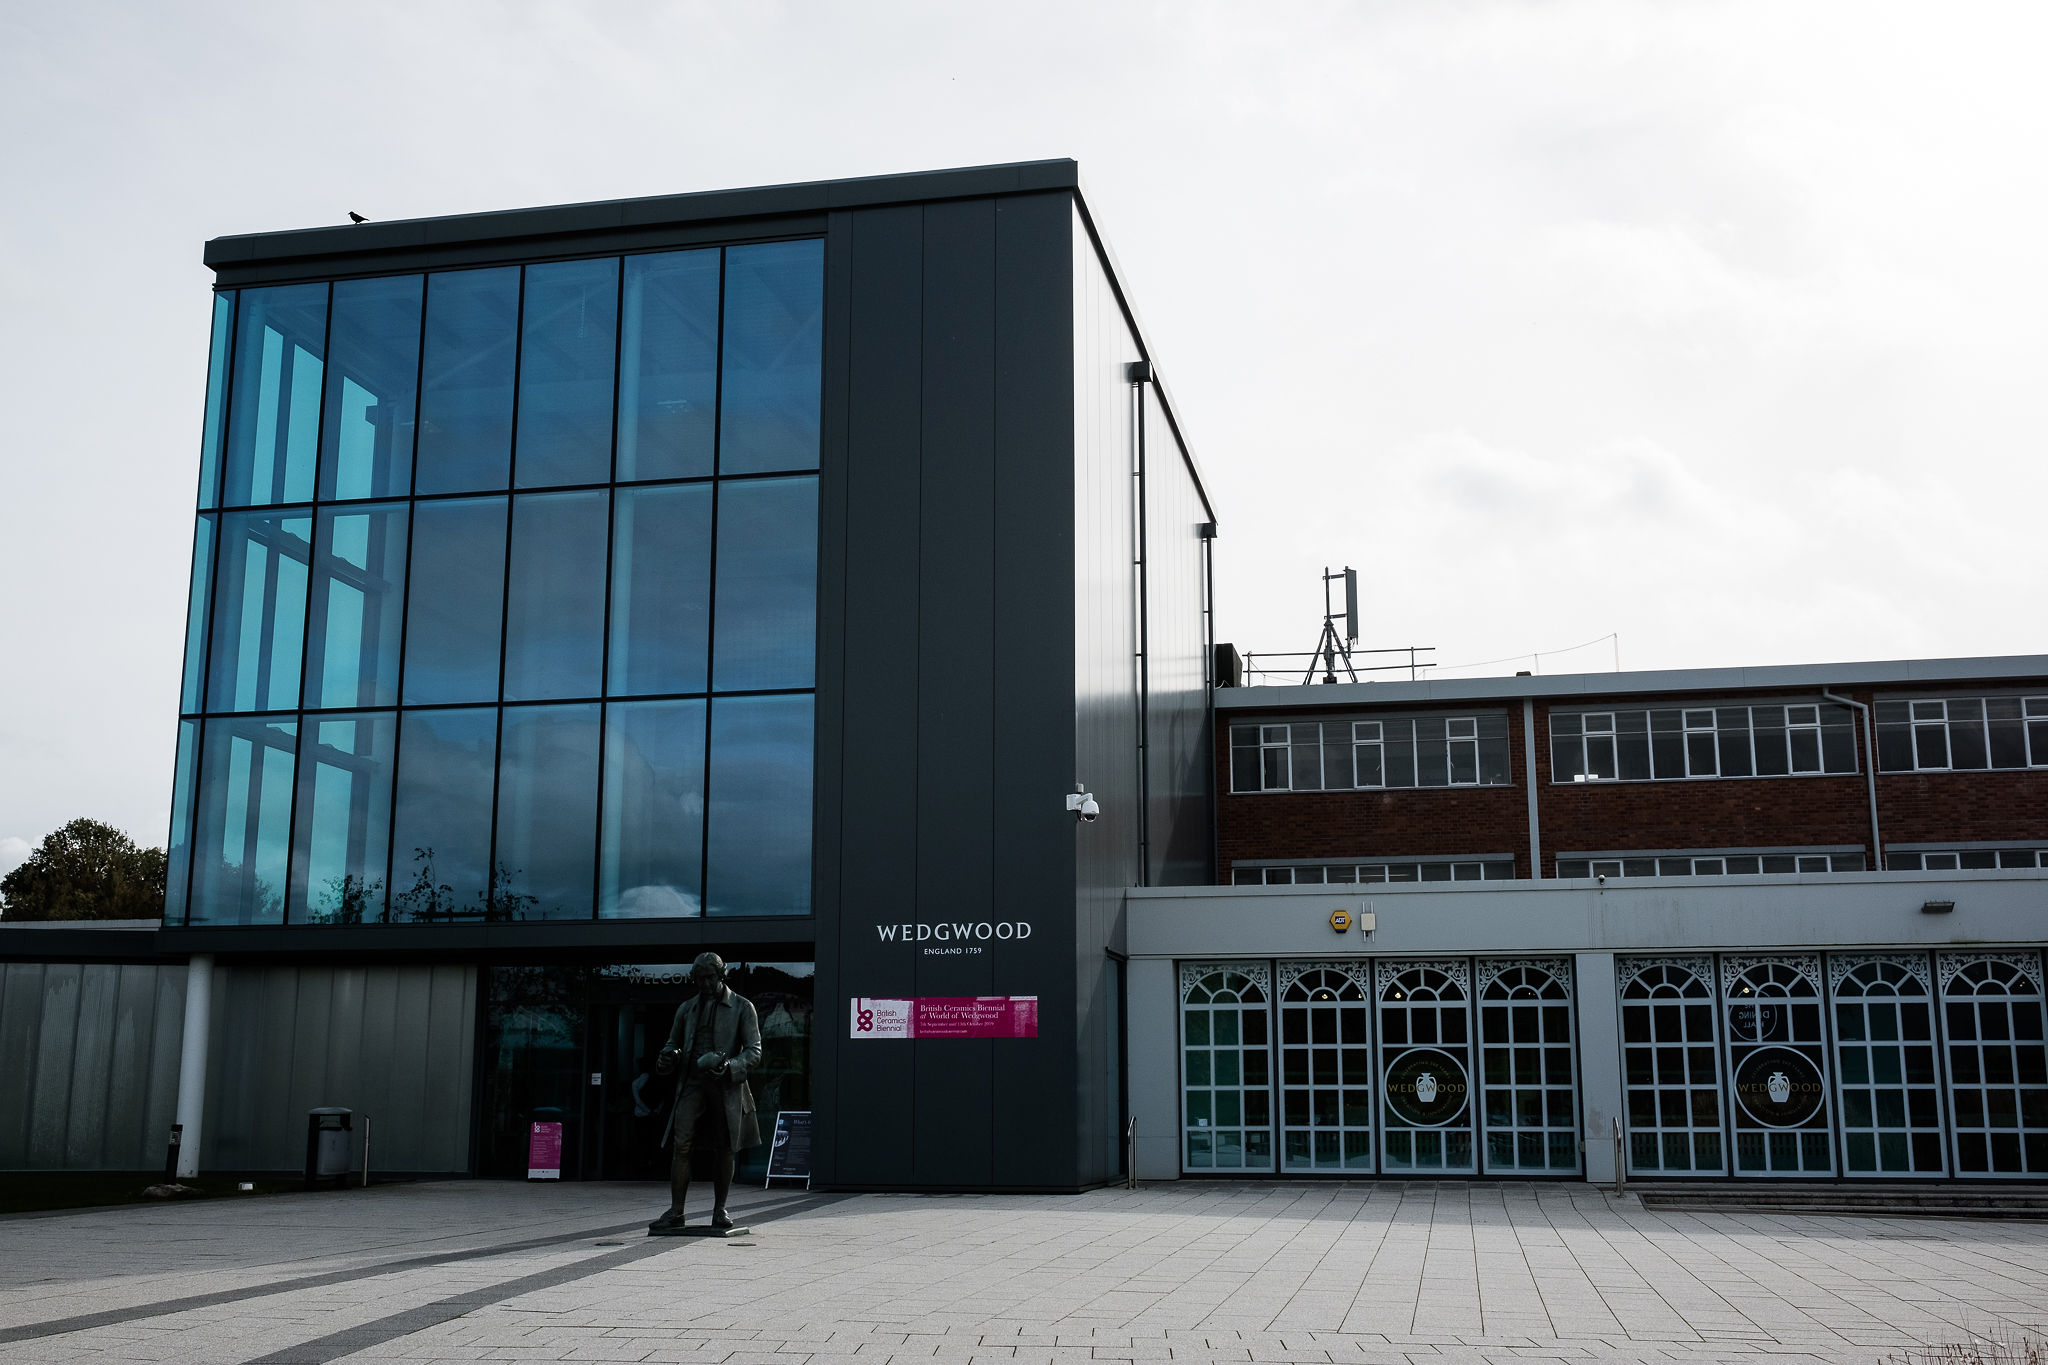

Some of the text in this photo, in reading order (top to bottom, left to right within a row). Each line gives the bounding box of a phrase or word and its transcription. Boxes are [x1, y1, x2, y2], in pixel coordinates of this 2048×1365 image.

[876, 922, 1032, 942] WEDGWOOD
[924, 947, 982, 955] ENGLAND 1759
[628, 972, 696, 984] WELCOM
[920, 1003, 1006, 1012] British Ceramics Biennial
[877, 1009, 897, 1017] British
[961, 1012, 999, 1020] Wedgwood
[1388, 1083, 1466, 1093] WEDGWOOD
[1738, 1082, 1821, 1093] WEDGWOOD
